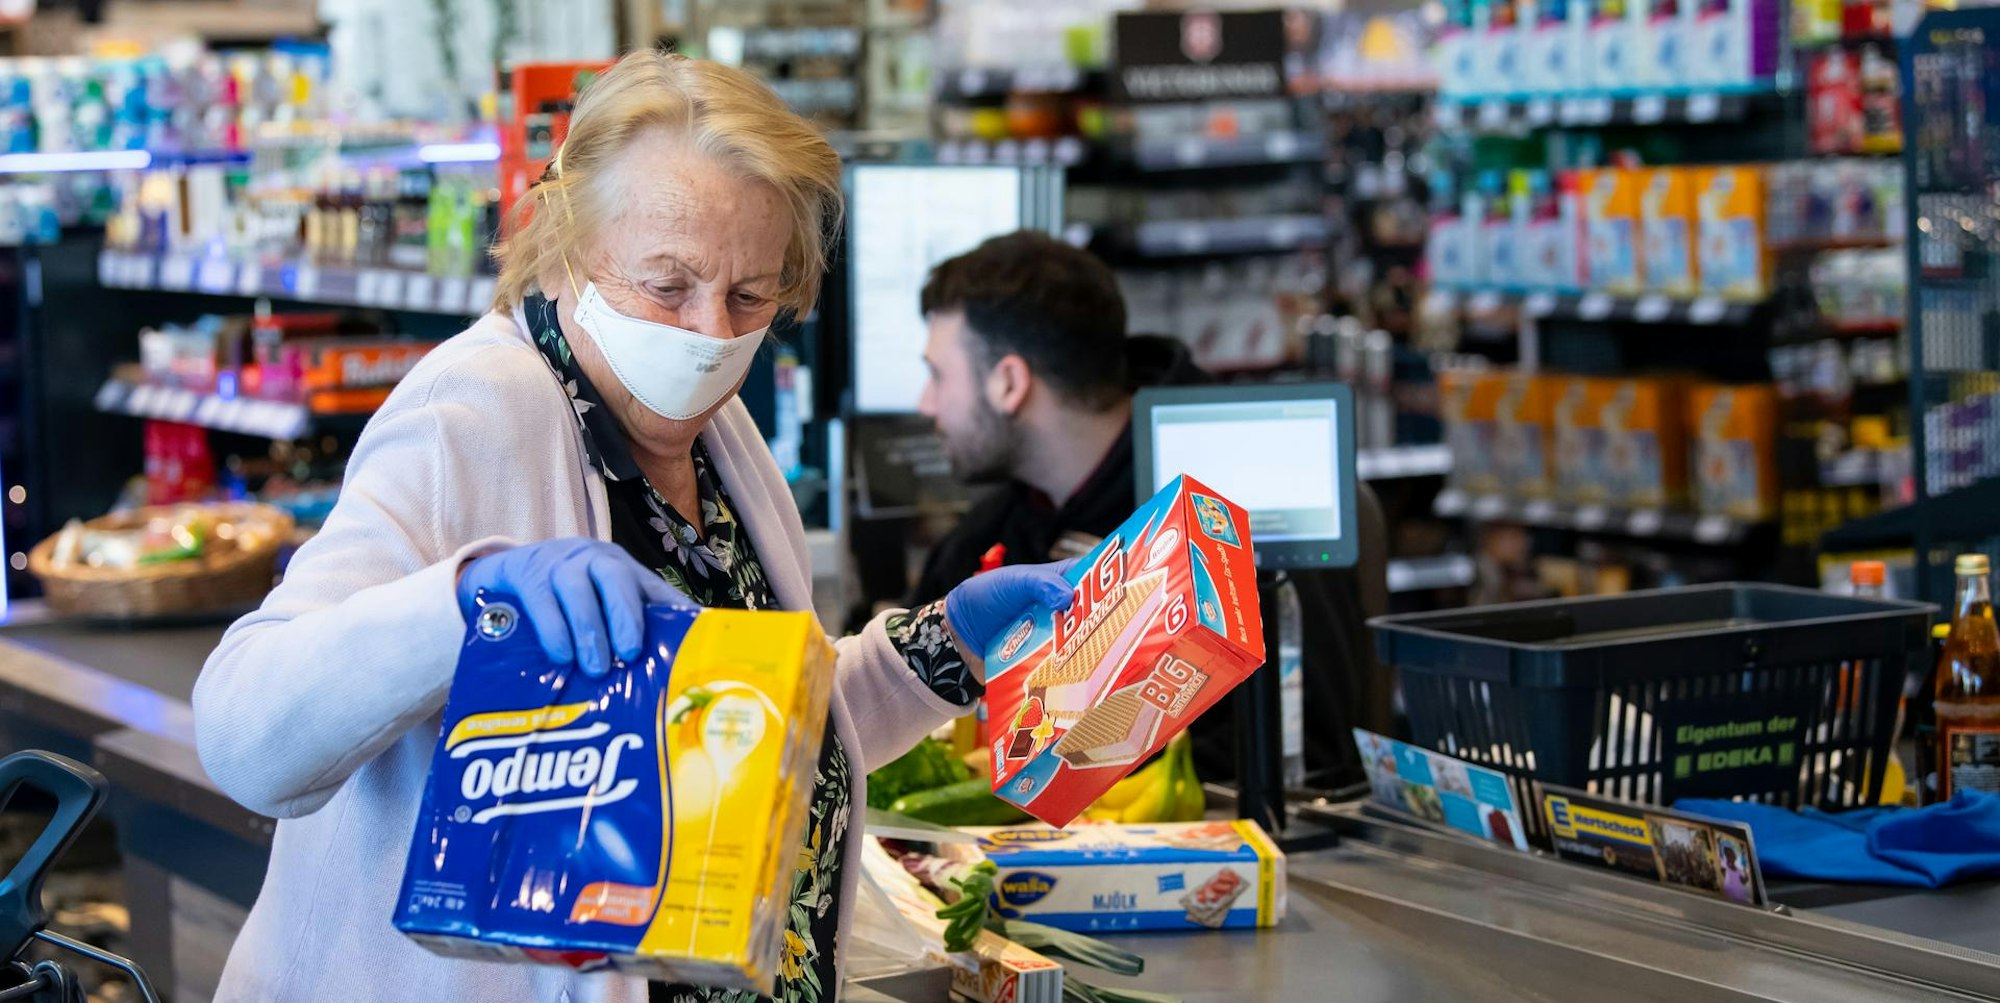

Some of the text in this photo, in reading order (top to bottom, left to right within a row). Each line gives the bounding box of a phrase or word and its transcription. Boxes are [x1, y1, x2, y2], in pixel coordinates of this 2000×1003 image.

[1051, 533, 1124, 654] BIG
[1165, 594, 1188, 634] 6
[1136, 653, 1197, 711] BIG
[1676, 715, 1798, 745] Eigentum der
[1697, 746, 1772, 772] EDEKA
[460, 733, 644, 822] Tempo
[1551, 800, 1570, 827] E
[1092, 890, 1137, 909] MJÖLK
